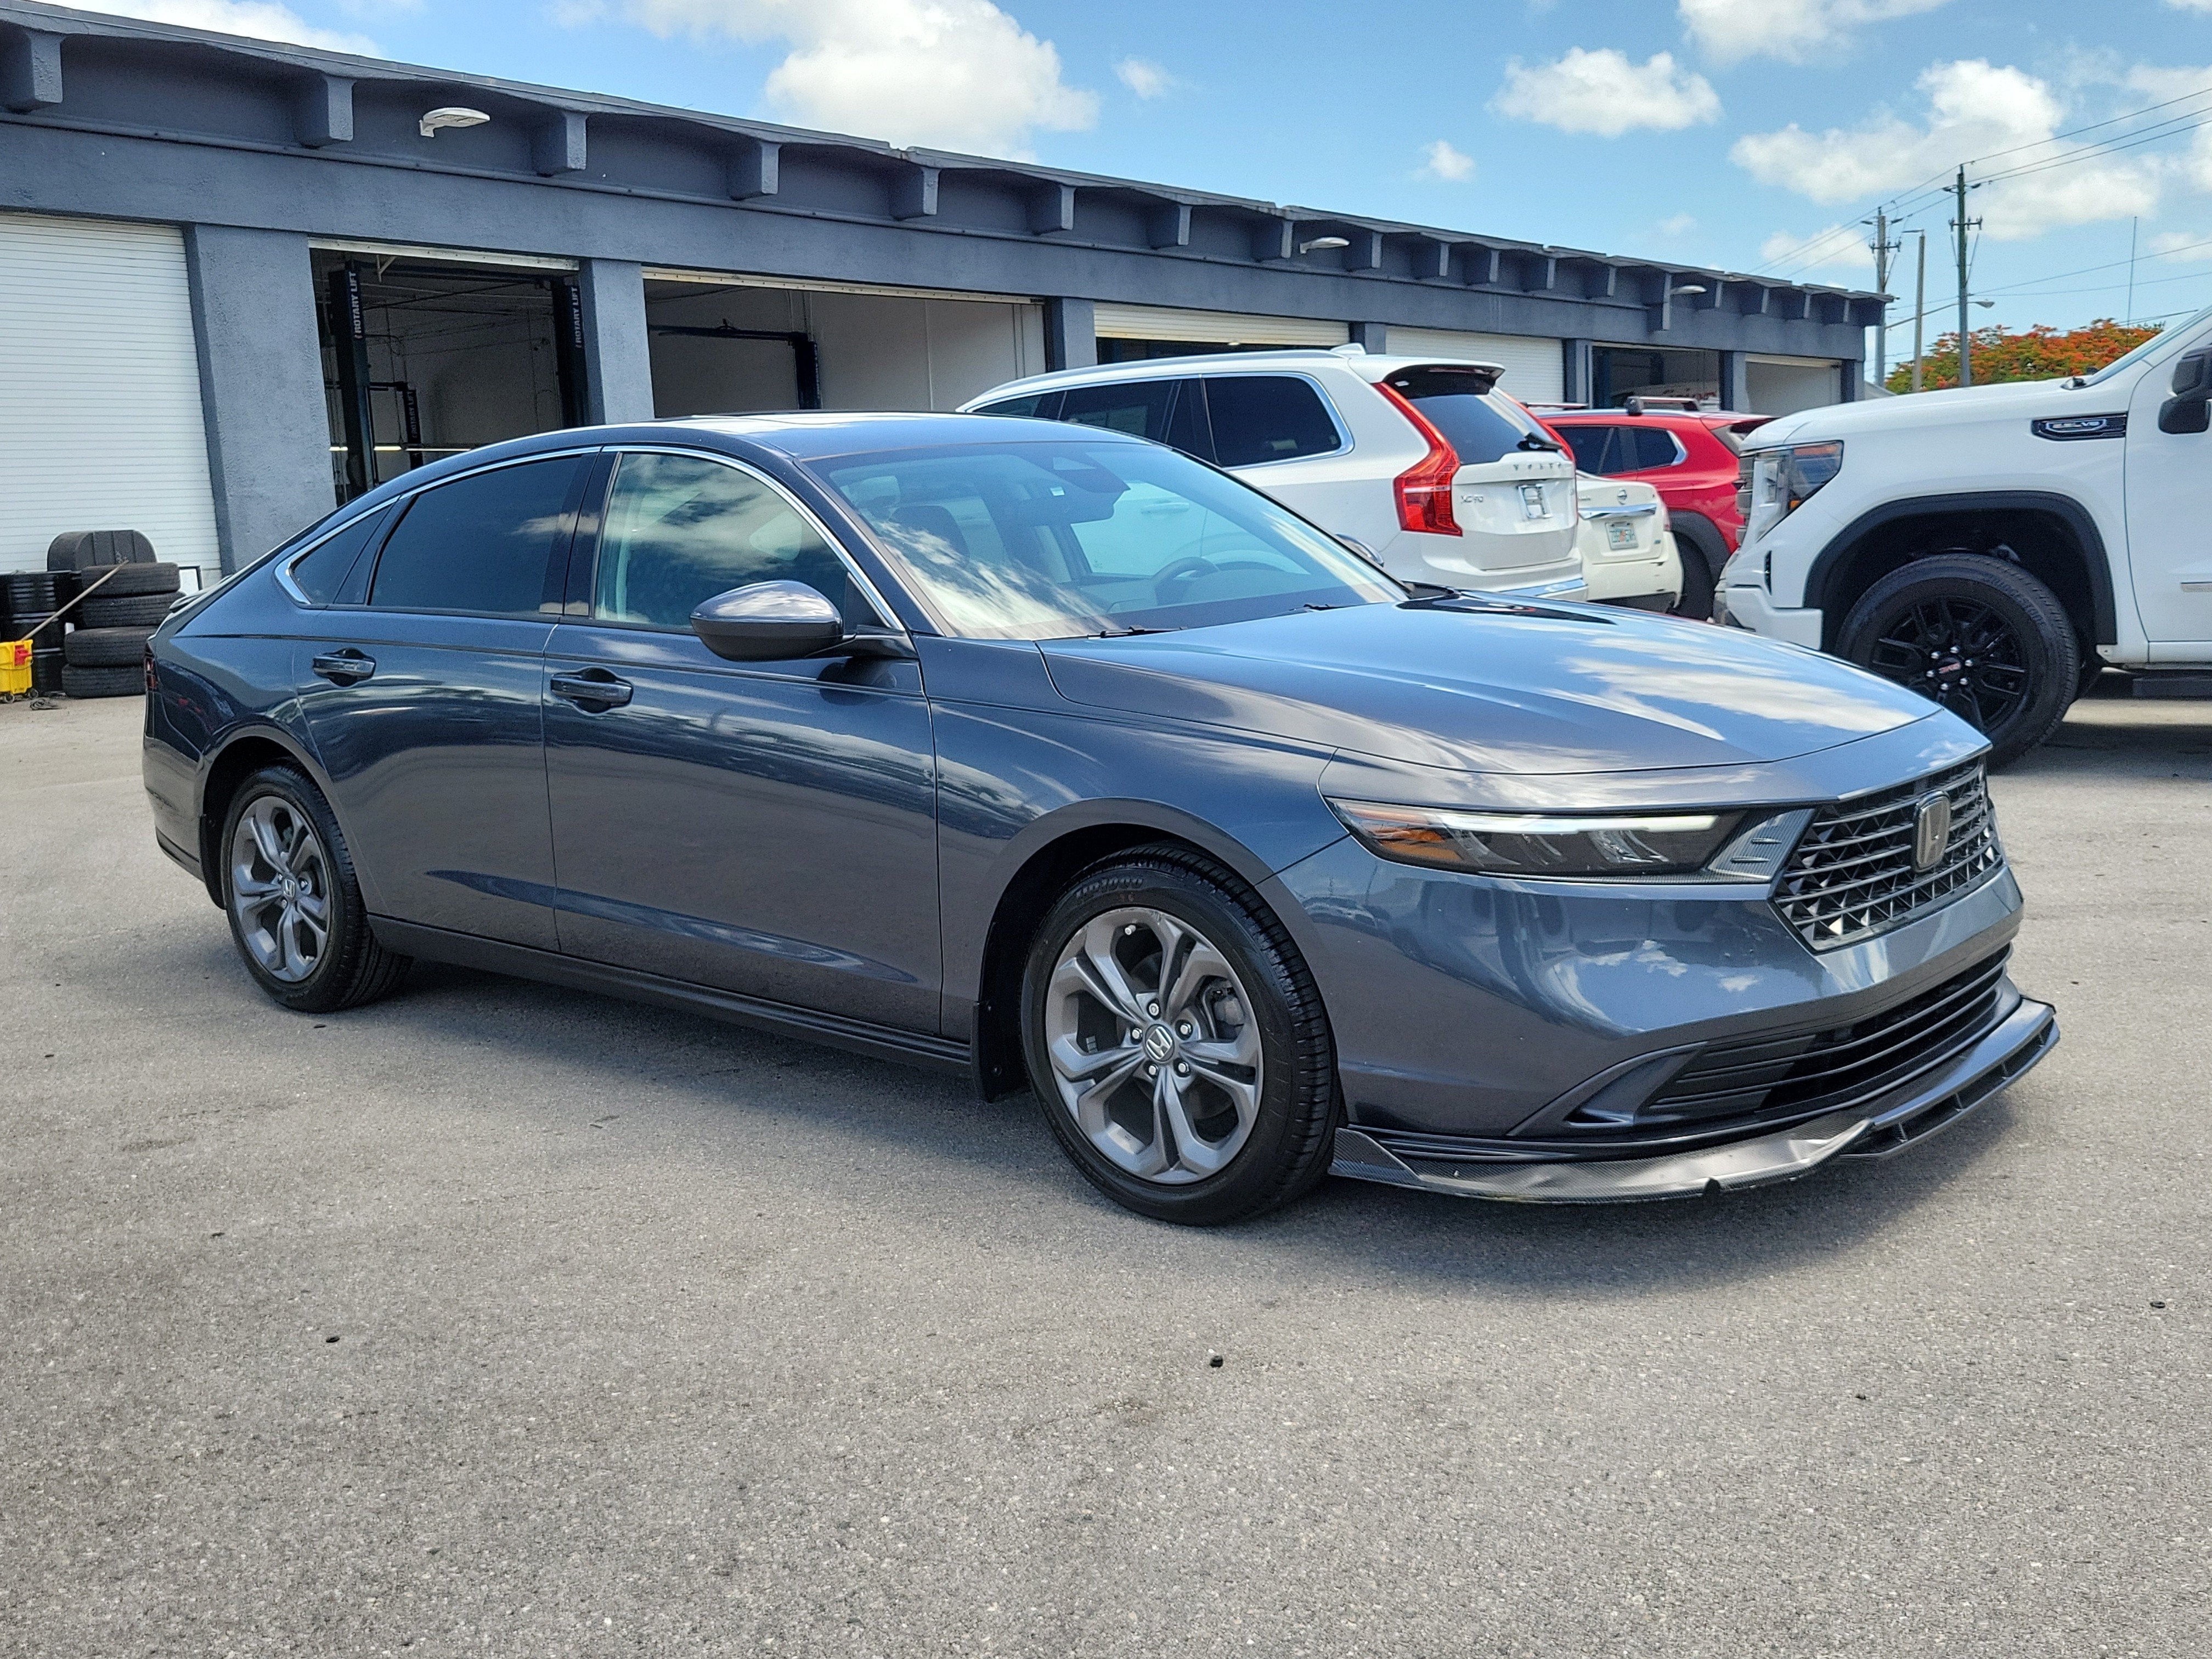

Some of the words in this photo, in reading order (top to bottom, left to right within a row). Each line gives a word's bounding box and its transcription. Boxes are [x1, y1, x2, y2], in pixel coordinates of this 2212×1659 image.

[348, 271, 358, 292] LIFT
[351, 294, 362, 334] ROTARY
[573, 308, 582, 343] ROTARY
